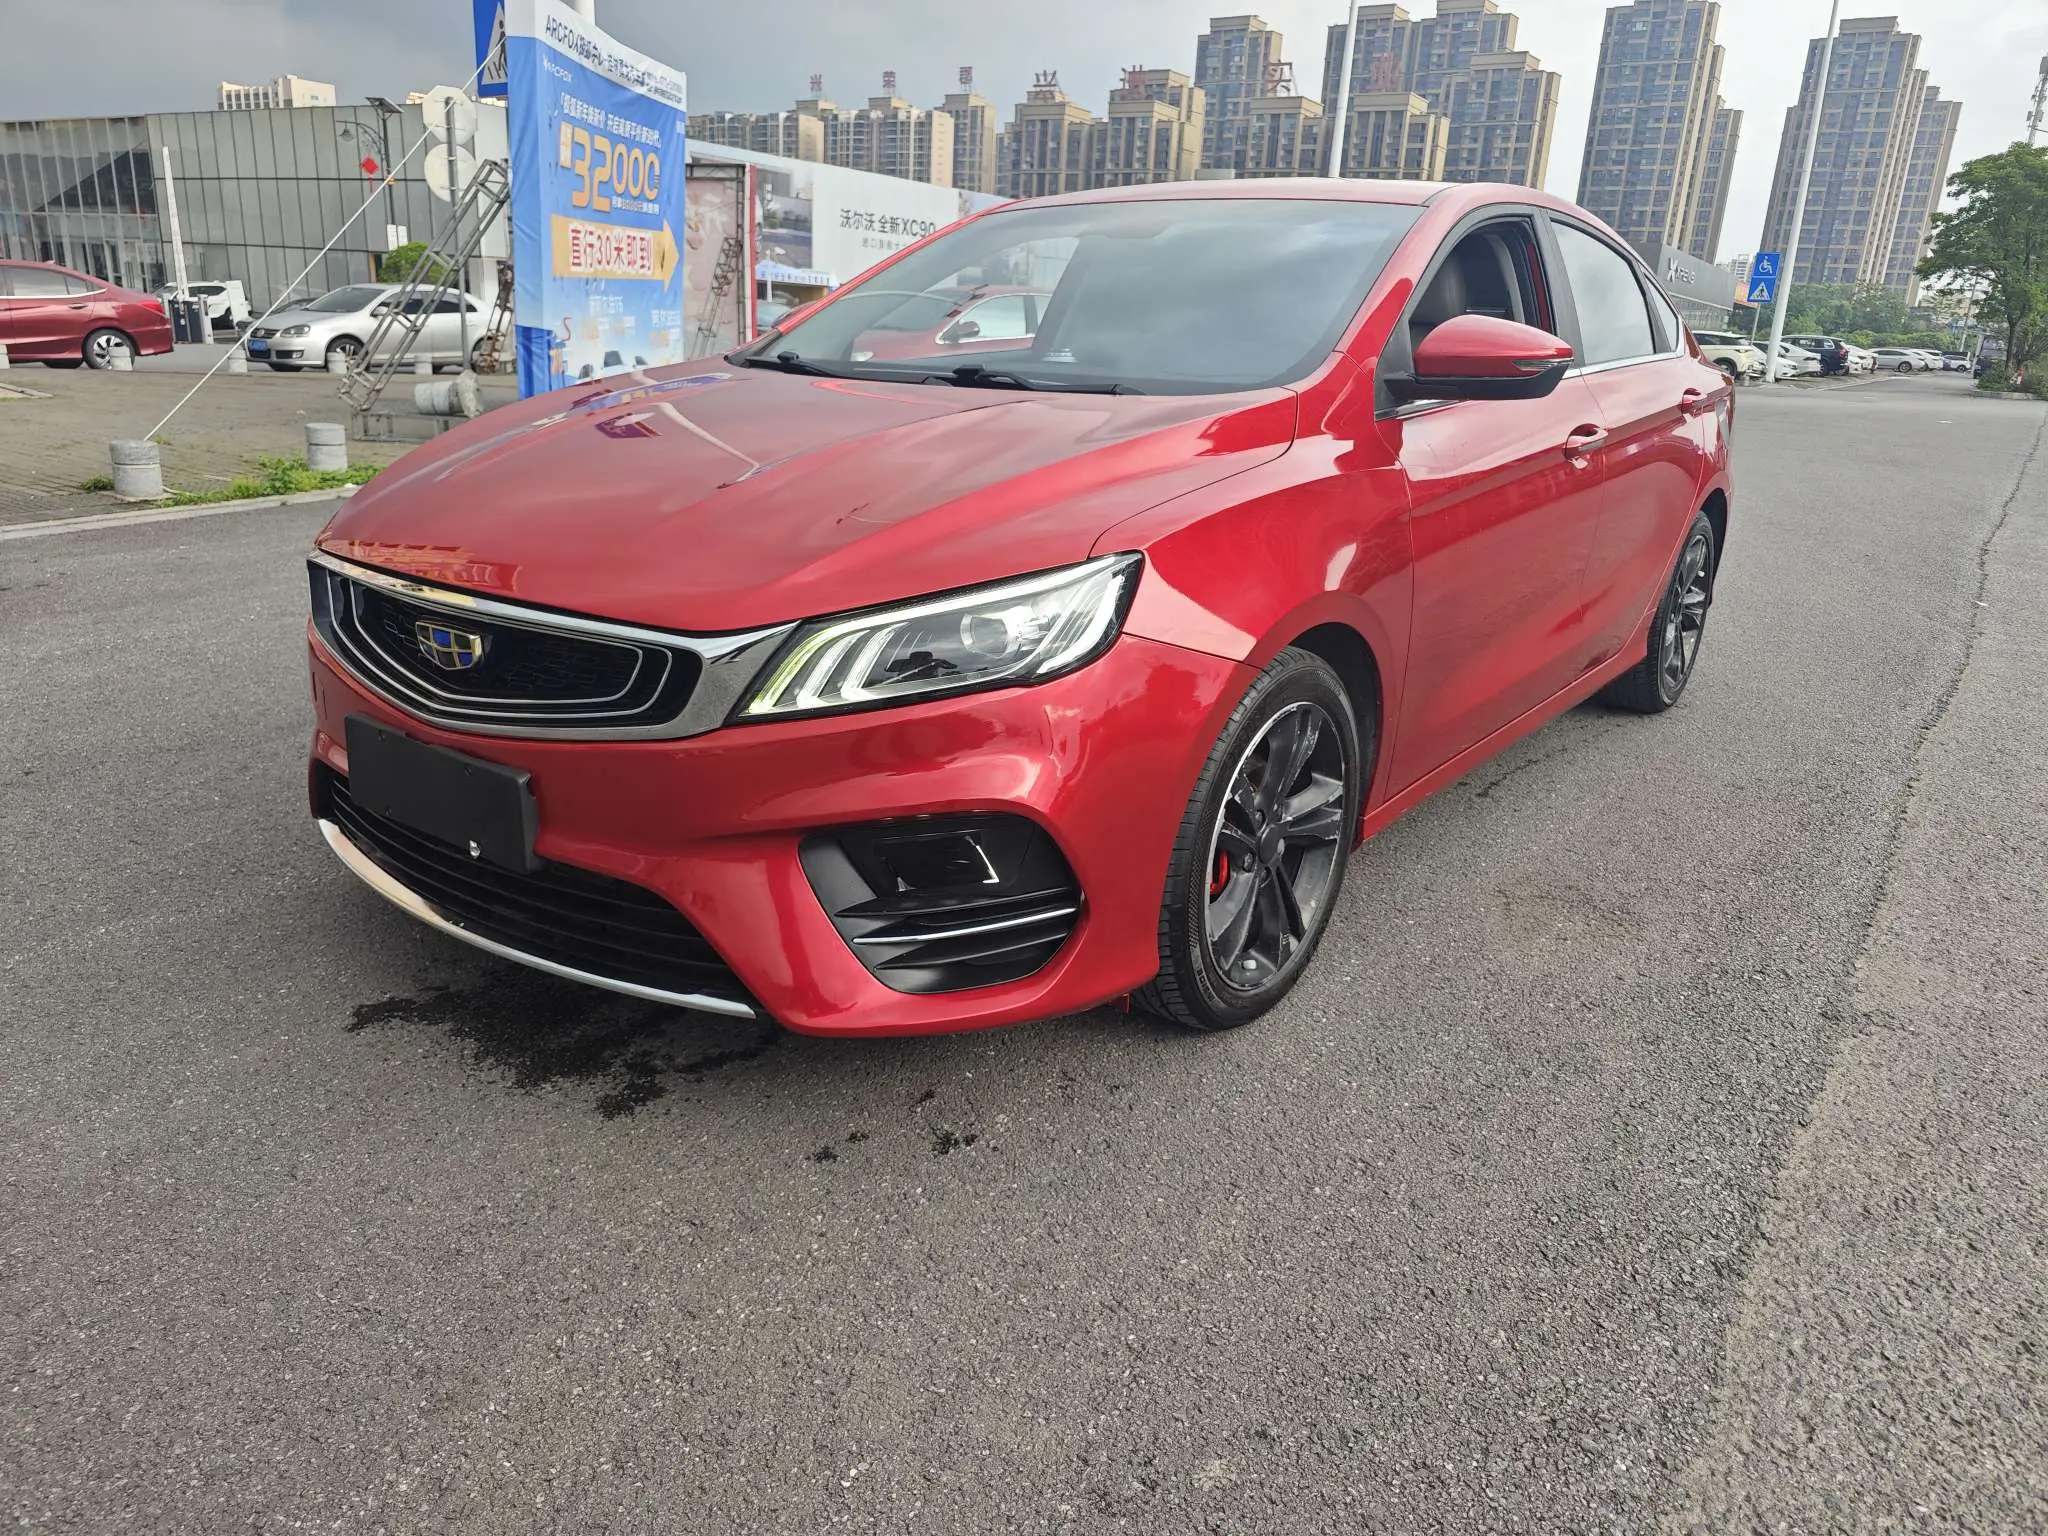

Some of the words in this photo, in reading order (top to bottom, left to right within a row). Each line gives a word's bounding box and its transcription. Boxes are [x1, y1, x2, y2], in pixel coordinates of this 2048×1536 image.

[570, 226, 652, 271] 直行30米即到
